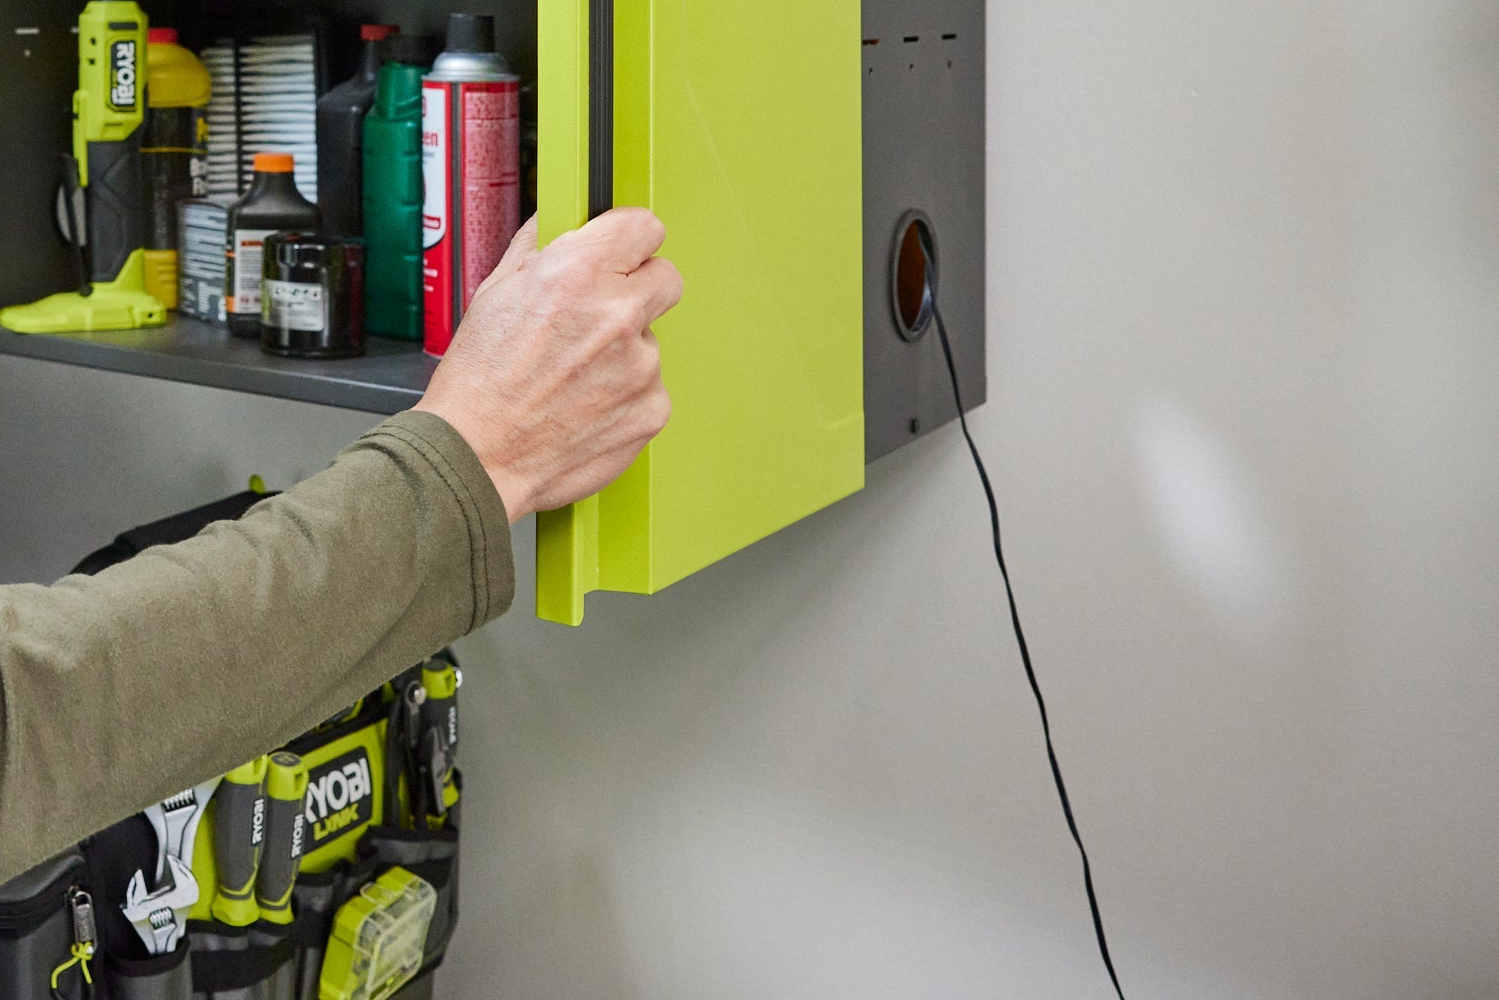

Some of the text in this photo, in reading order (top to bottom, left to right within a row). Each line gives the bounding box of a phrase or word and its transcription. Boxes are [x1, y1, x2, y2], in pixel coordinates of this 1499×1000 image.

[116, 41, 136, 105] RYOBI
[251, 798, 265, 845] RYOBI
[290, 813, 305, 859] RYOBI
